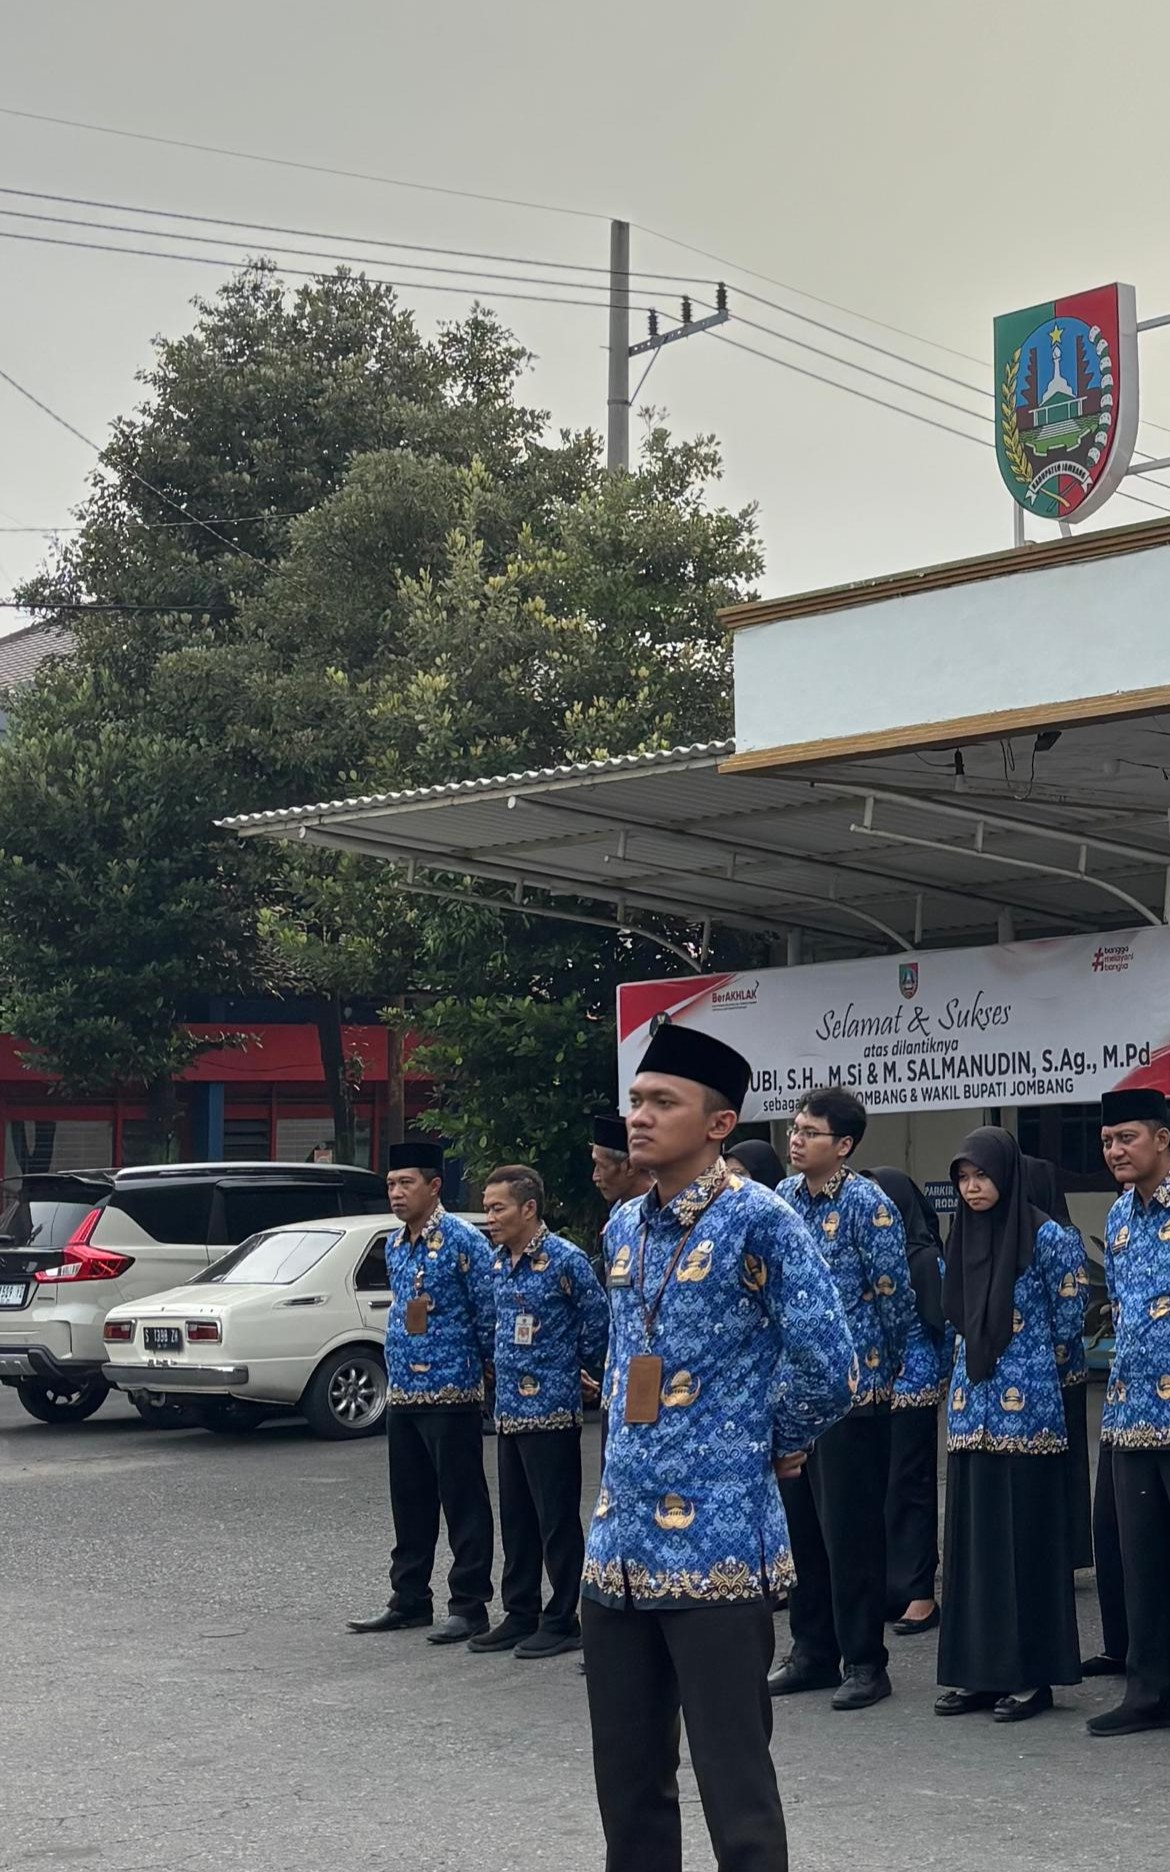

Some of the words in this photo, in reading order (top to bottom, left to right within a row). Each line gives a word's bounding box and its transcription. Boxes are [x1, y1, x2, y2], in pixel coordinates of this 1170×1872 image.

[712, 982, 759, 1003] BerAKHLAK
[815, 1003, 904, 1041] Selamat
[907, 1006, 930, 1037] &
[938, 990, 1011, 1031] Sukses
[863, 1043, 889, 1058] atas
[891, 1036, 959, 1056] dilantiknya
[750, 1069, 783, 1095] UBI,
[828, 1063, 862, 1087] M.Si
[866, 1062, 879, 1085] &
[883, 1060, 902, 1084] M.
[907, 1050, 1037, 1082] SALMANUDIN,
[1042, 1048, 1097, 1075] S.Ag.,
[1103, 1041, 1151, 1069] M.Pd
[763, 1097, 801, 1112] sebaga
[855, 1088, 908, 1106] OMBANG
[910, 1087, 918, 1103] &
[921, 1084, 960, 1102] WAKIL
[963, 1081, 1007, 1099] BUPATI
[1010, 1077, 1074, 1097] JOMBANG
[924, 1185, 954, 1196] PARKIR
